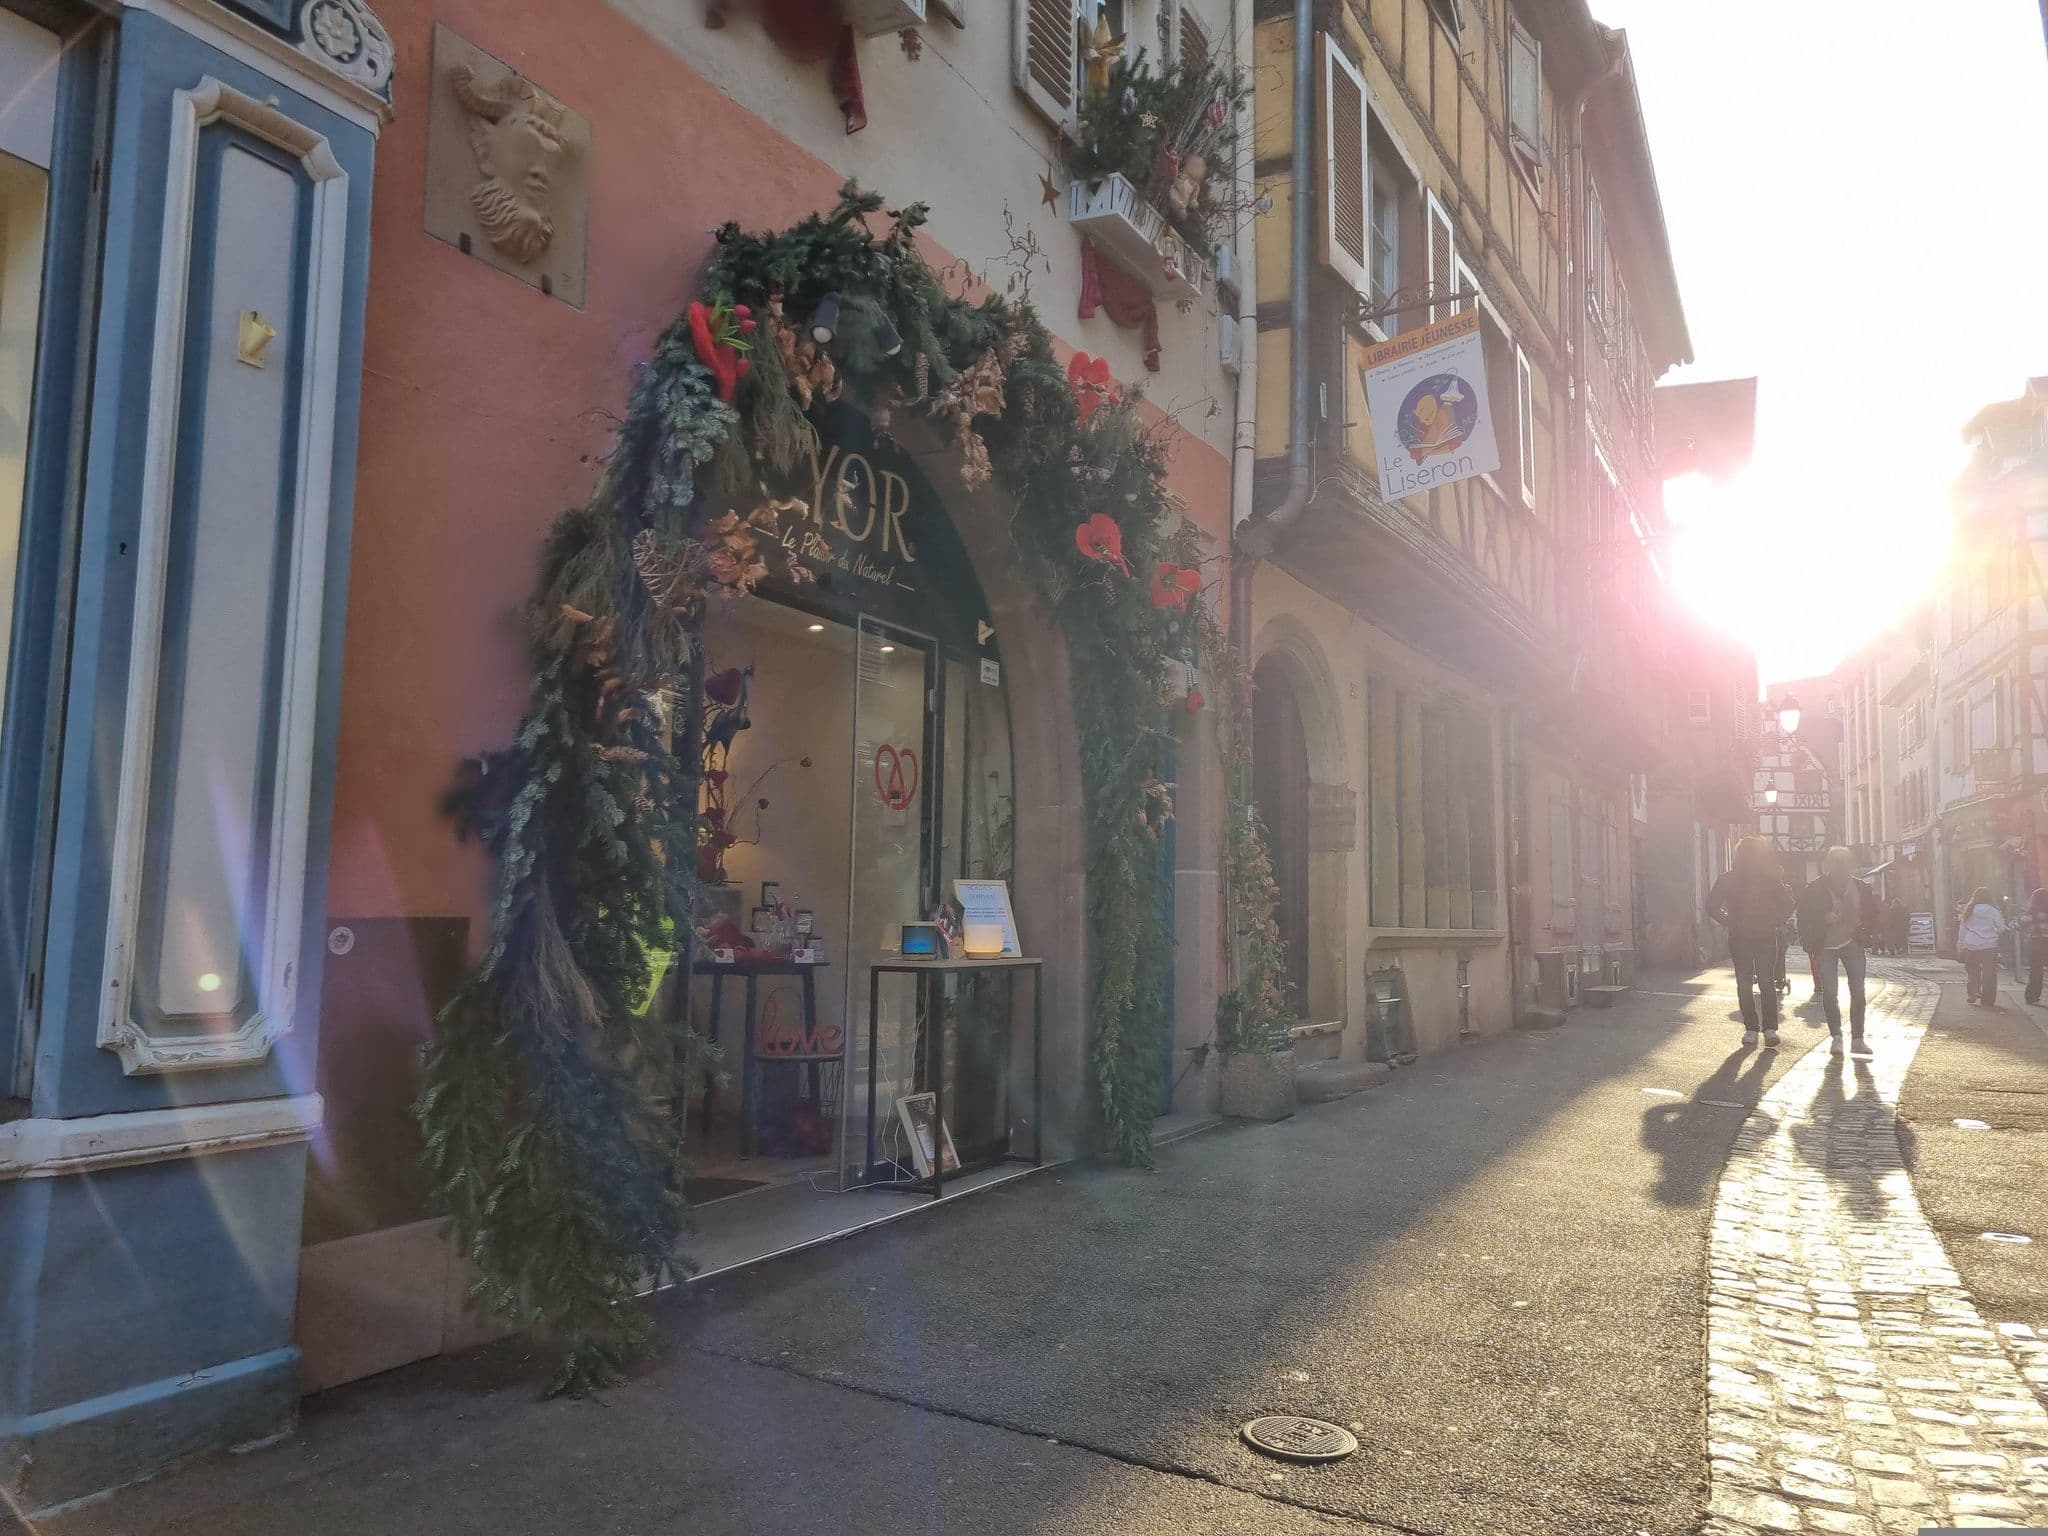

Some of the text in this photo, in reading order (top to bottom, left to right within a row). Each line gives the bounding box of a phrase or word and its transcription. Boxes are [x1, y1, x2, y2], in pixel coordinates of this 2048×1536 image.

[1367, 338, 1420, 366] LIBRAIRIE
[1419, 317, 1476, 347] JEUNESSE
[1384, 455, 1404, 472] Le
[1386, 455, 1474, 496] Liseron
[781, 525, 796, 550] Le
